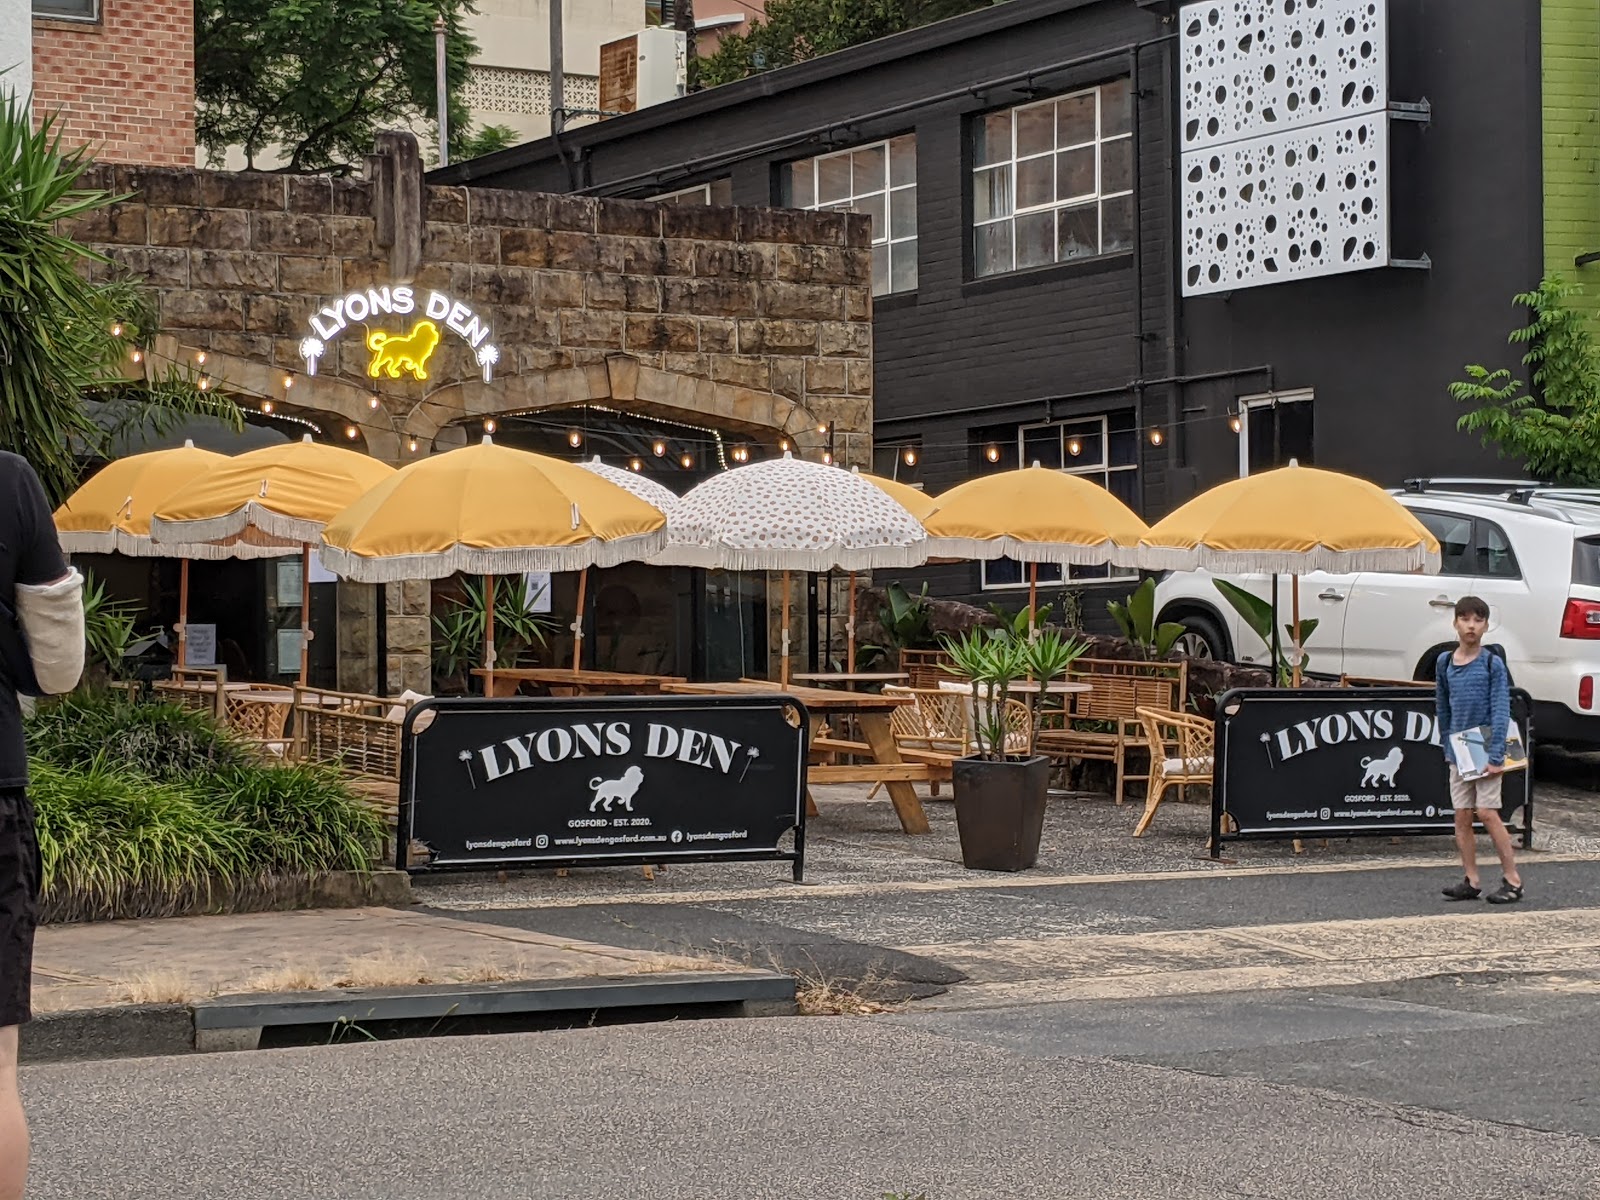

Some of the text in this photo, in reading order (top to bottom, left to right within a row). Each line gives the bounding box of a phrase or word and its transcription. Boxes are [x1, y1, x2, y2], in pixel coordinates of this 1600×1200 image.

[311, 287, 489, 348] LYONS DEN
[1275, 709, 1394, 761] LYONS
[478, 721, 742, 782] LYONS DEN
[567, 818, 608, 828] GOSFORD
[613, 818, 630, 827] EST.
[630, 817, 653, 826] 2020.
[553, 834, 668, 847] www.lyonsdengosford.com.au
[686, 829, 748, 842] lyonsdengosford
[465, 838, 532, 851] lyonsdengosford
